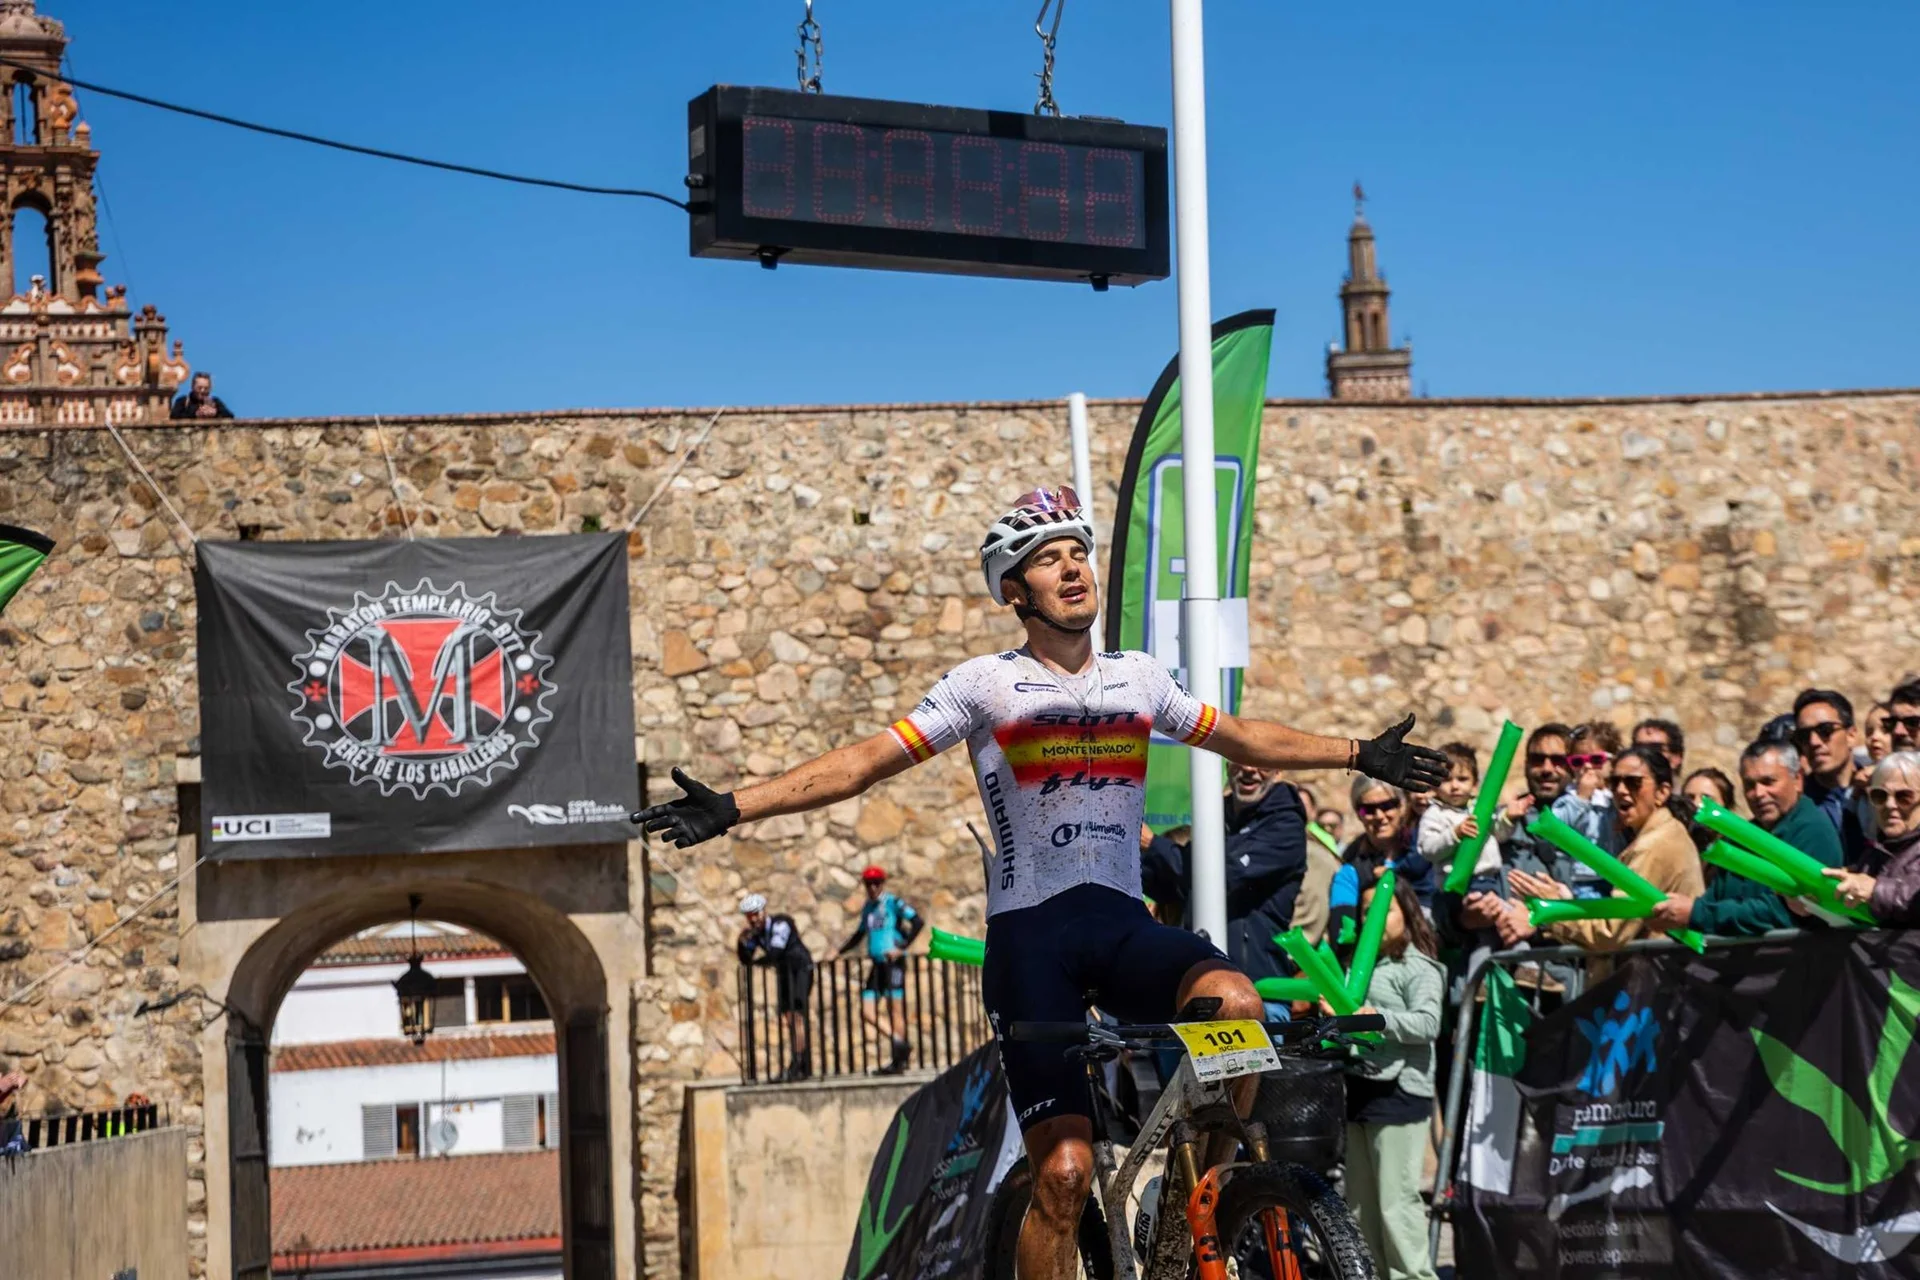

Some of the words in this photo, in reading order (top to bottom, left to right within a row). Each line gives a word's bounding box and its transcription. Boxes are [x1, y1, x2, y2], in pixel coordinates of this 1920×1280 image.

[315, 601, 386, 660] MARATON
[329, 735, 373, 771] JEREZ
[372, 756, 396, 780] DE
[397, 763, 426, 784] LOS
[430, 729, 516, 780] CABALLEROS
[224, 820, 271, 835] UCI
[984, 771, 1015, 891] SHIMANO
[1204, 1029, 1246, 1046] 101
